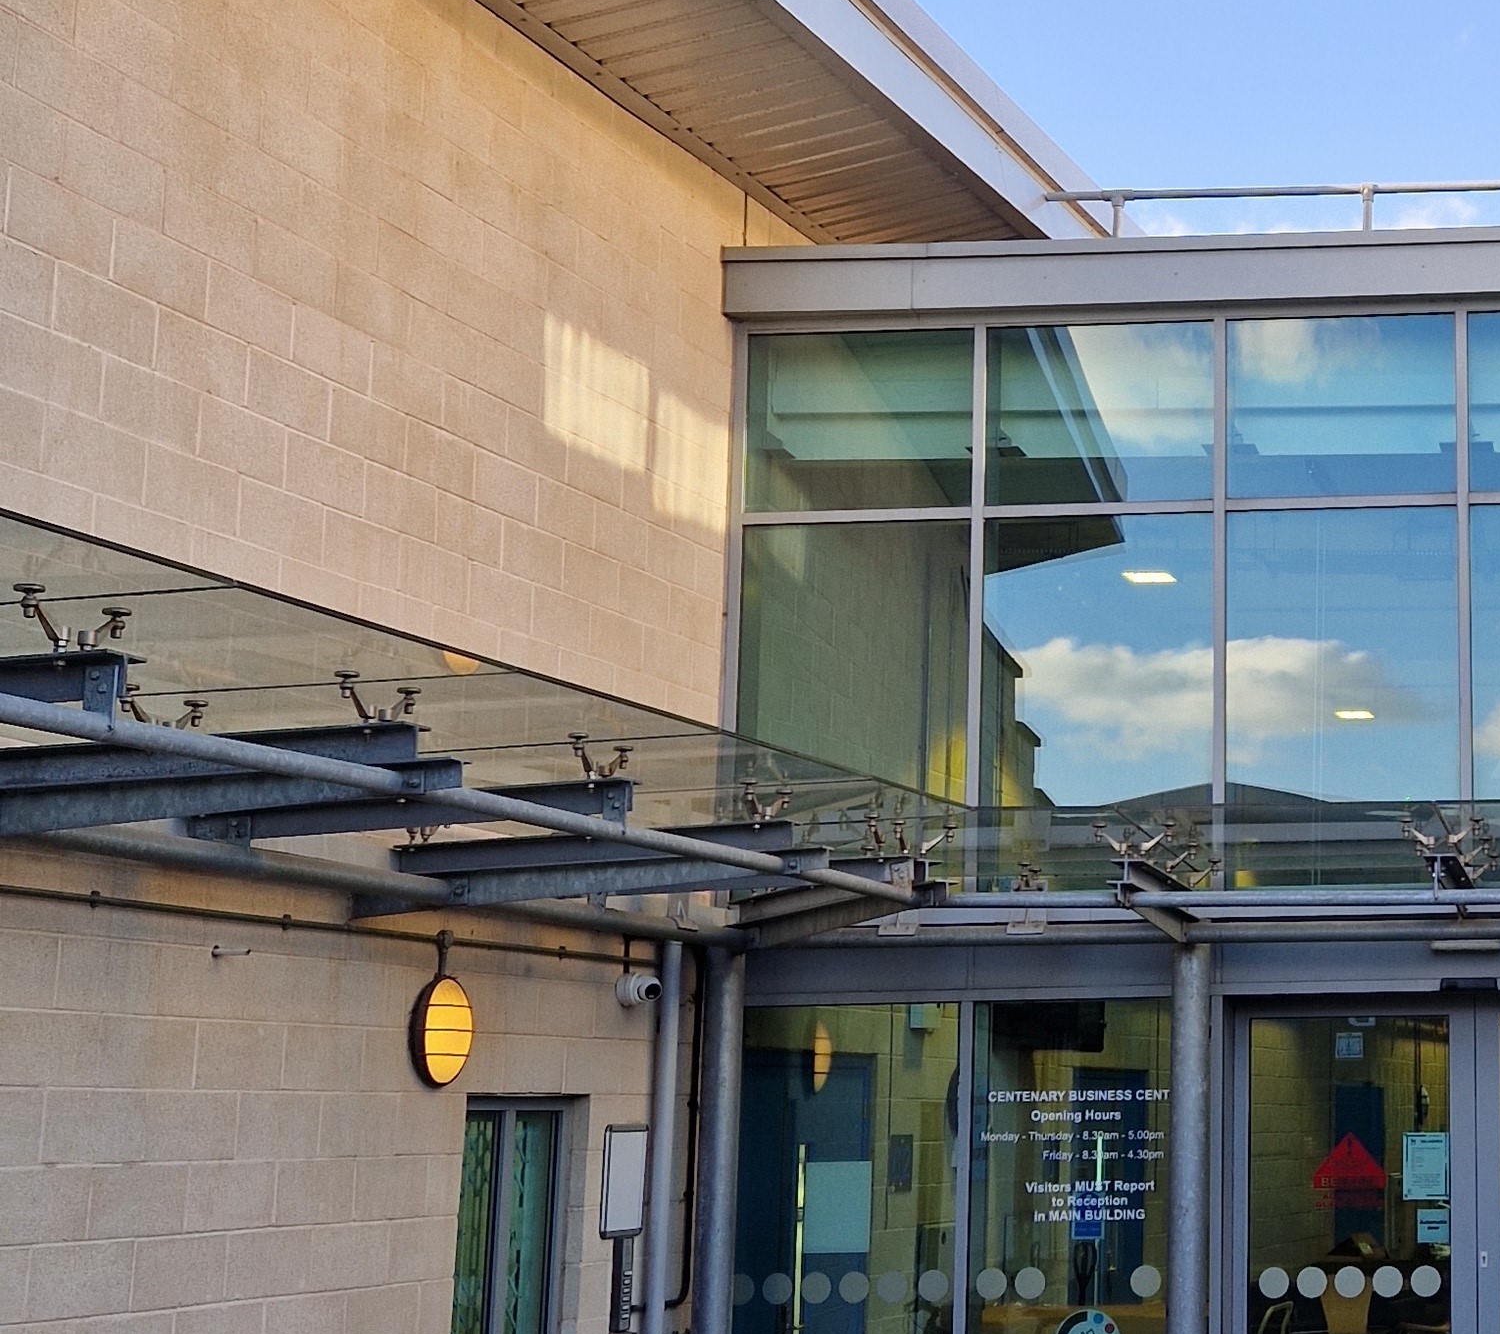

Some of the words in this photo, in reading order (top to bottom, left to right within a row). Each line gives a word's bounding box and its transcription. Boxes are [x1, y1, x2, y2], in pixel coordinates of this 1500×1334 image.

[988, 1090, 1066, 1103] CENTENARY
[1068, 1089, 1133, 1102] BUSINESS
[1135, 1089, 1170, 1101] CENT
[1031, 1109, 1082, 1123] Opening
[1085, 1109, 1121, 1121] Hours
[980, 1131, 1020, 1144] Monday
[1028, 1131, 1074, 1143] Thursday
[1082, 1130, 1119, 1141] 8.30am
[1127, 1130, 1165, 1143] 5.00pm
[1042, 1150, 1073, 1162] Friday
[1127, 1150, 1165, 1162] 4.30pm
[1025, 1181, 1071, 1193] Visitors
[1075, 1180, 1110, 1192] MUST
[1114, 1180, 1155, 1194] Report
[1051, 1196, 1064, 1207] to
[1067, 1195, 1128, 1209] Reception
[1049, 1210, 1081, 1221] MAIN
[1084, 1209, 1146, 1221] BUILDING
